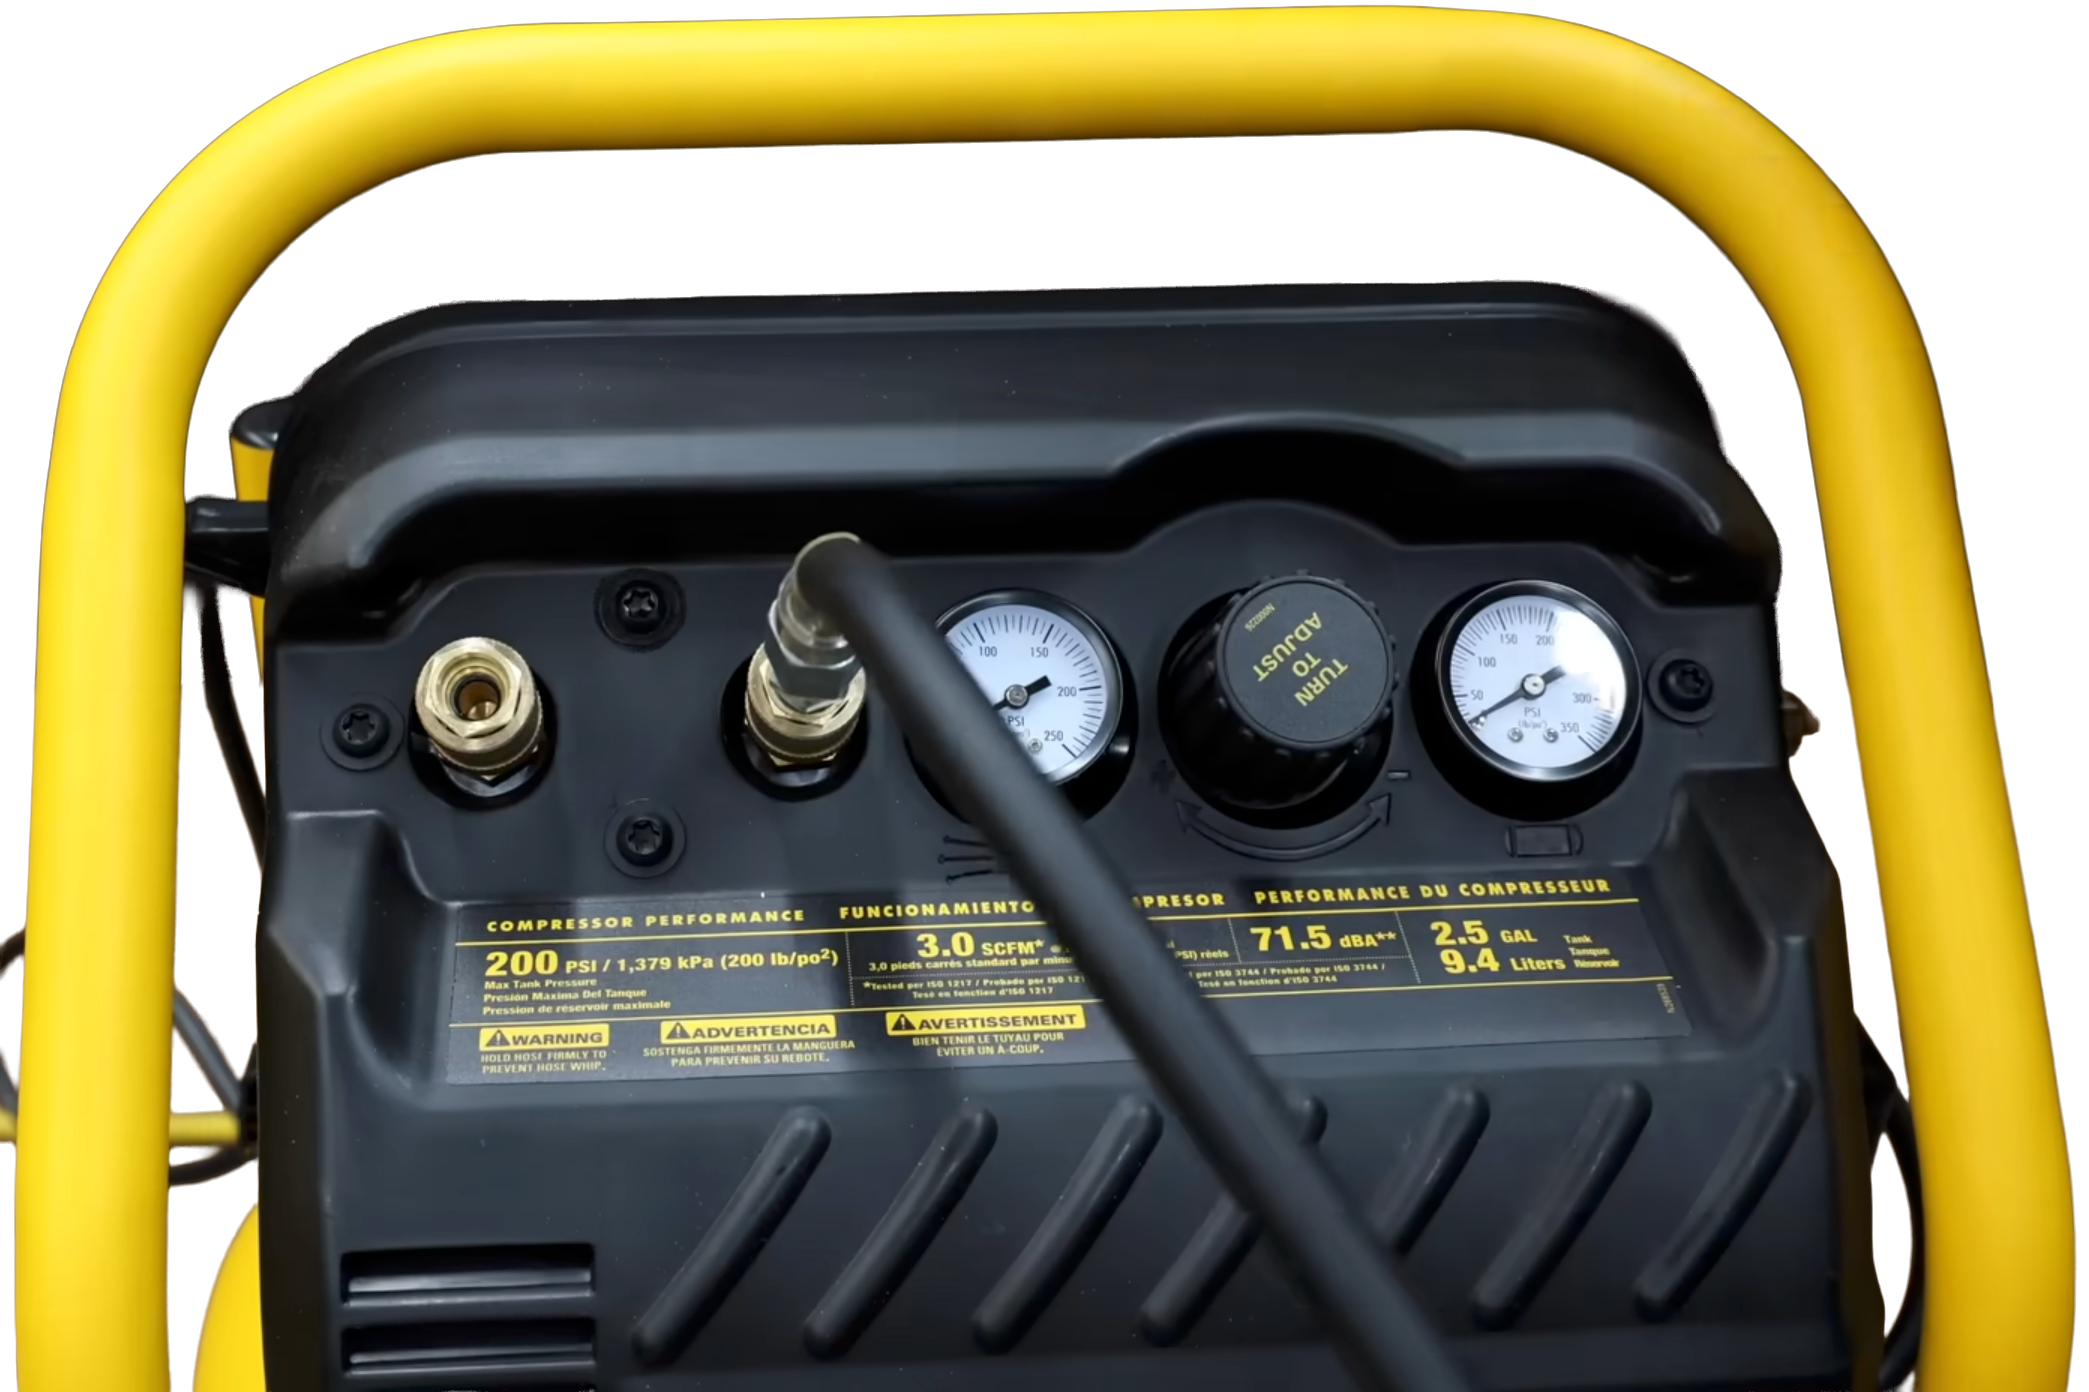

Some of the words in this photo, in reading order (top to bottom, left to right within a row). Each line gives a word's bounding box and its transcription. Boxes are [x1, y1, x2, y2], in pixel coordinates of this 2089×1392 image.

[1500, 634, 1518, 644] 150
[1536, 635, 1555, 645] 200
[979, 646, 997, 657] 100
[1031, 647, 1049, 658] 150
[1253, 612, 1323, 682] ADJUST
[1292, 652, 1321, 677] TO
[1478, 657, 1496, 668] 100
[1294, 658, 1349, 707] TURN
[1057, 686, 1076, 697] 200
[1471, 690, 1483, 700] 50
[1573, 693, 1591, 704] 300
[1524, 707, 1541, 717] PSI
[1007, 716, 1025, 726] PSI
[1561, 722, 1579, 733] 350
[1044, 731, 1063, 741] 250
[1254, 884, 1410, 905] PERFORMANCE
[1419, 884, 1448, 898] DU
[1458, 878, 1611, 896] COMPRESSEUR
[839, 900, 1035, 920] FUNCIONAMIENTO
[486, 916, 634, 933] COMPRESSOR
[645, 909, 805, 928] PERFORMANCE
[1250, 925, 1332, 952] 71.5
[1430, 920, 1490, 945] 2.5
[1500, 929, 1538, 943] GAL
[916, 932, 974, 958] 3.0
[1562, 934, 1593, 944] Tank
[1568, 948, 1610, 957] Tanque
[484, 949, 558, 977] 200
[565, 959, 597, 974] PSI
[602, 958, 611, 973] /
[616, 956, 672, 974] 1,379
[678, 954, 713, 970] kPa
[720, 953, 763, 970] (200
[869, 962, 887, 972] 3,0
[891, 960, 922, 971] pieds
[965, 957, 1017, 968] standard
[1021, 958, 1040, 967] par
[1043, 956, 1073, 964] minu
[1439, 948, 1500, 974] 9.4
[1510, 958, 1566, 972] Liters
[484, 980, 509, 990] Max
[512, 979, 542, 989] Tank
[545, 977, 597, 987] Pressure
[583, 990, 601, 998] Del
[605, 989, 647, 999] Tanque
[483, 1006, 534, 1015] Pression
[538, 1005, 553, 1013] de
[613, 1000, 671, 1010] maximale
[919, 1014, 1076, 1031] AVERTISSEMENT
[692, 1023, 831, 1039] ADVERTENCIA
[512, 1032, 602, 1046] WARNING
[913, 1036, 939, 1046] BIEN
[943, 1035, 975, 1044] TENIR
[978, 1035, 991, 1043] LE
[994, 1033, 1031, 1043] TUYAU
[1034, 1032, 1065, 1041] POUR
[643, 1046, 701, 1057] SOSTENGA
[704, 1044, 773, 1055] FIRMEMENTE
[776, 1043, 790, 1052] LA
[793, 1041, 855, 1050] MANGUERA
[978, 1046, 994, 1055] UN
[481, 1054, 511, 1062] HOLD
[547, 1051, 590, 1060] FIRMLY
[593, 1050, 607, 1059] TO
[671, 1057, 702, 1067] PARA
[705, 1055, 761, 1065] PREVENIR
[764, 1055, 779, 1064] SU
[482, 1064, 532, 1073] PREVENT
